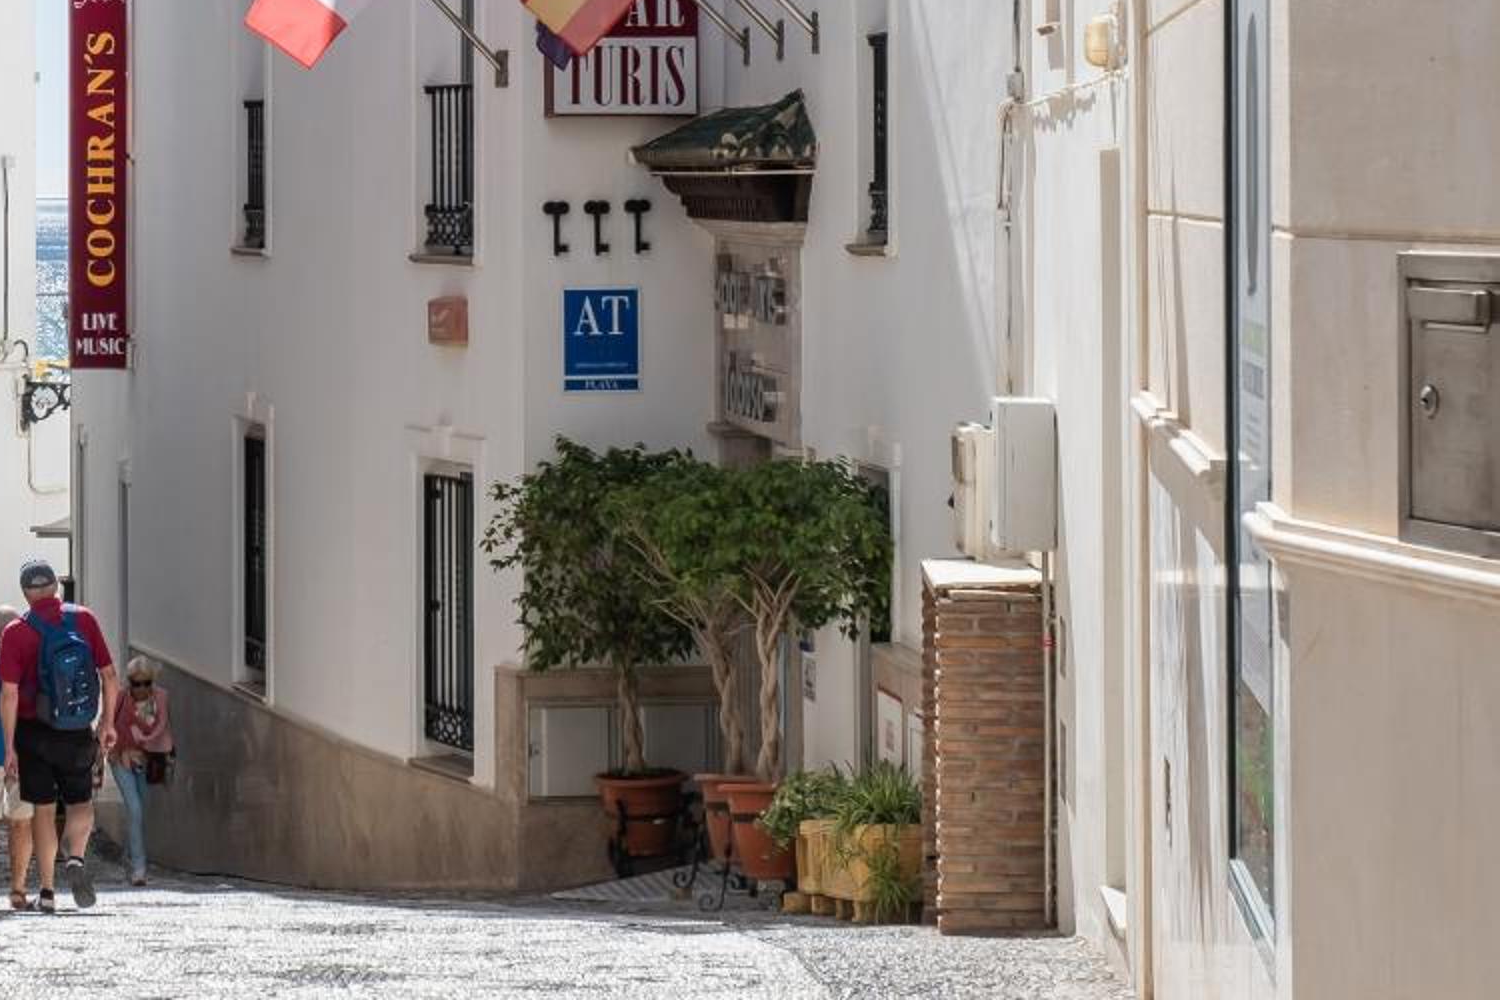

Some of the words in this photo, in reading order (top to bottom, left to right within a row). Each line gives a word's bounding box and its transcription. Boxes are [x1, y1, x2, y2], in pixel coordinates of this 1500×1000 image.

[570, 45, 686, 107] TURIS
[84, 31, 116, 288] COCHRAN'S
[82, 313, 118, 332] LIVE
[572, 295, 630, 336] AT
[76, 335, 125, 355] MUSIC
